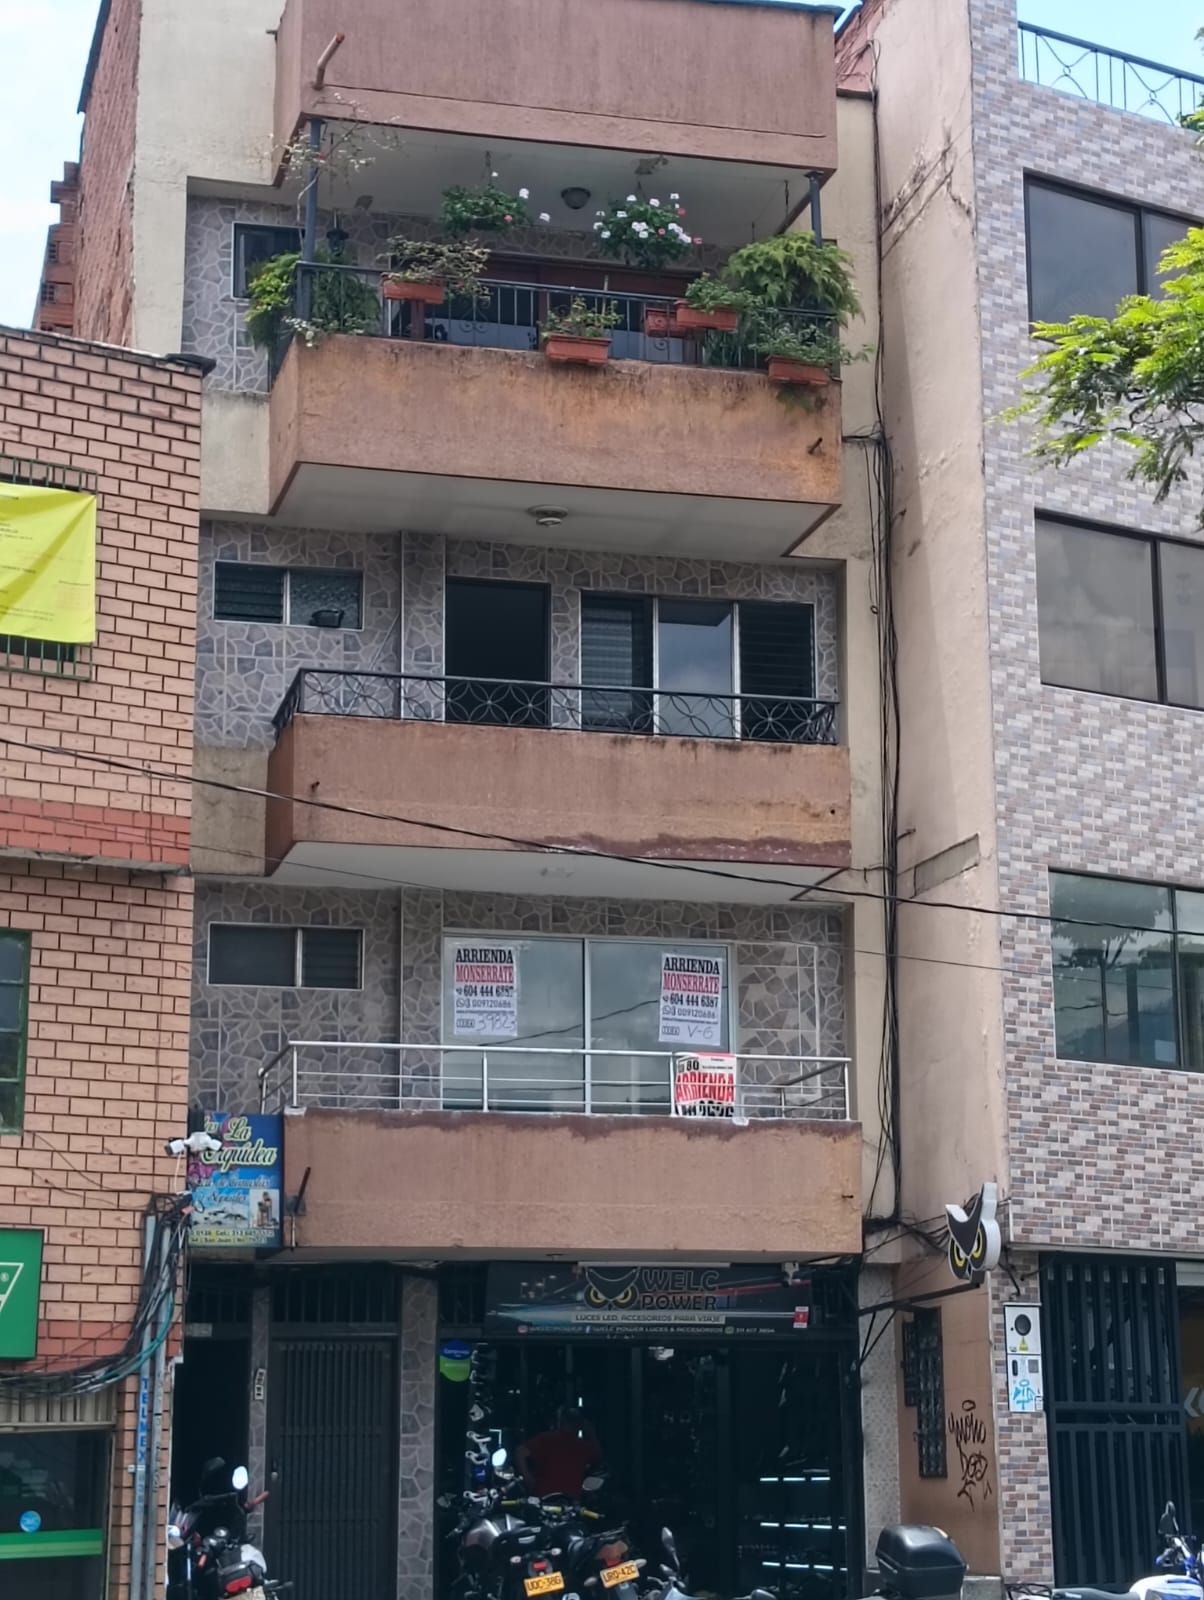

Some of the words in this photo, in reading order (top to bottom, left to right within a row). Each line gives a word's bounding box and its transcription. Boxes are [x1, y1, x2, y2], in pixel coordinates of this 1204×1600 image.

[455, 948, 514, 964] ARRIENDA
[663, 956, 720, 975] ARRIENDA
[455, 964, 514, 984] MONSERRATE
[663, 972, 720, 994] MONSERRATE
[464, 985, 478, 997] 604
[480, 985, 494, 997] 444
[670, 992, 684, 1006] 604
[686, 994, 699, 1007] 444
[675, 1071, 735, 1103] ARRIENDA
[224, 1117, 252, 1141] La
[641, 1268, 720, 1292] WELC
[640, 1294, 718, 1310] POWER
